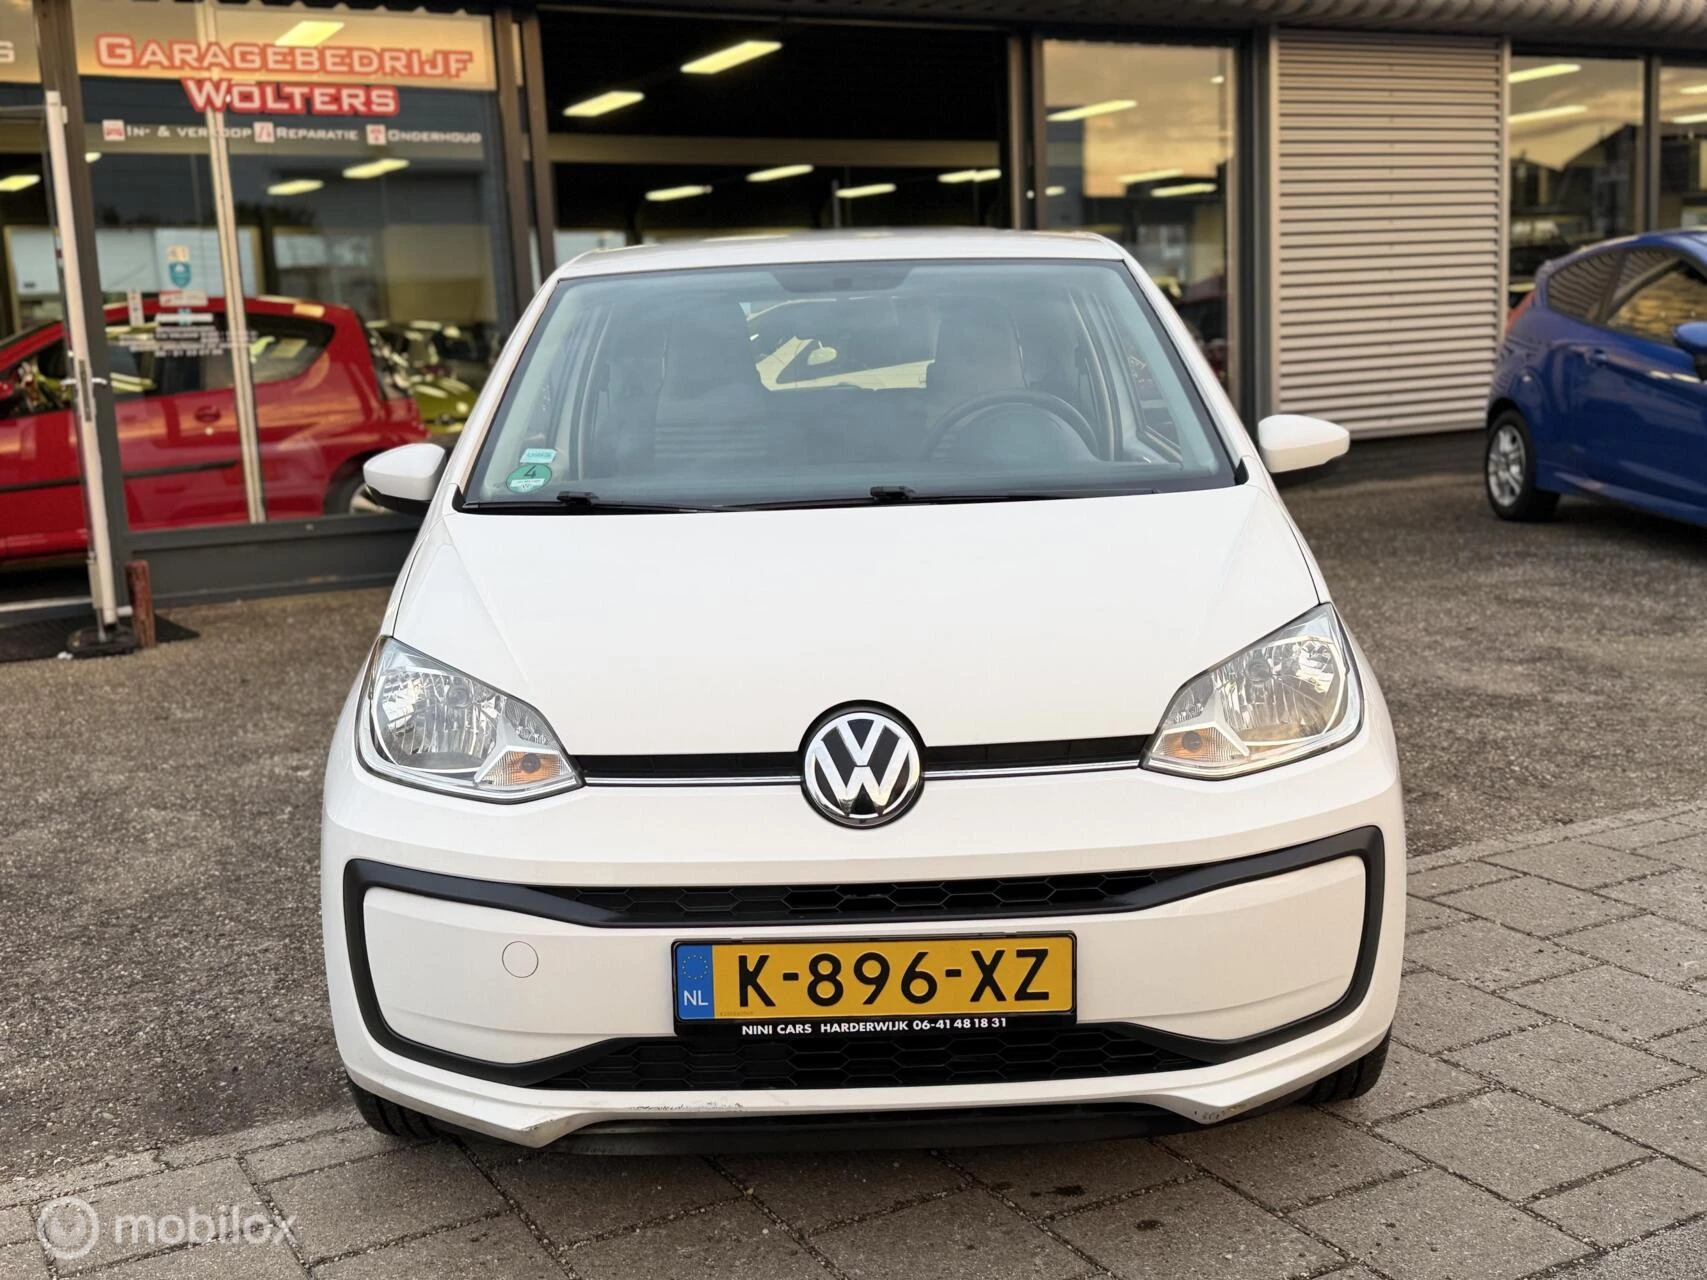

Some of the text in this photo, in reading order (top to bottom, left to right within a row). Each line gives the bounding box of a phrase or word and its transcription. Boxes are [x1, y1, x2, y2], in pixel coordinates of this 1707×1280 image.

[97, 36, 472, 77] GARAGEBEDRIJF
[184, 78, 397, 115] WOLTERS
[157, 125, 171, 138] &
[276, 127, 359, 141] REPARATIE
[523, 464, 537, 479] 4
[804, 712, 921, 820] VW
[737, 948, 1051, 1008] K-896-XZ
[683, 989, 709, 1006] NL
[741, 1017, 1007, 1036] NINI CARS HARDERWIJK 06-41 48 18 31
